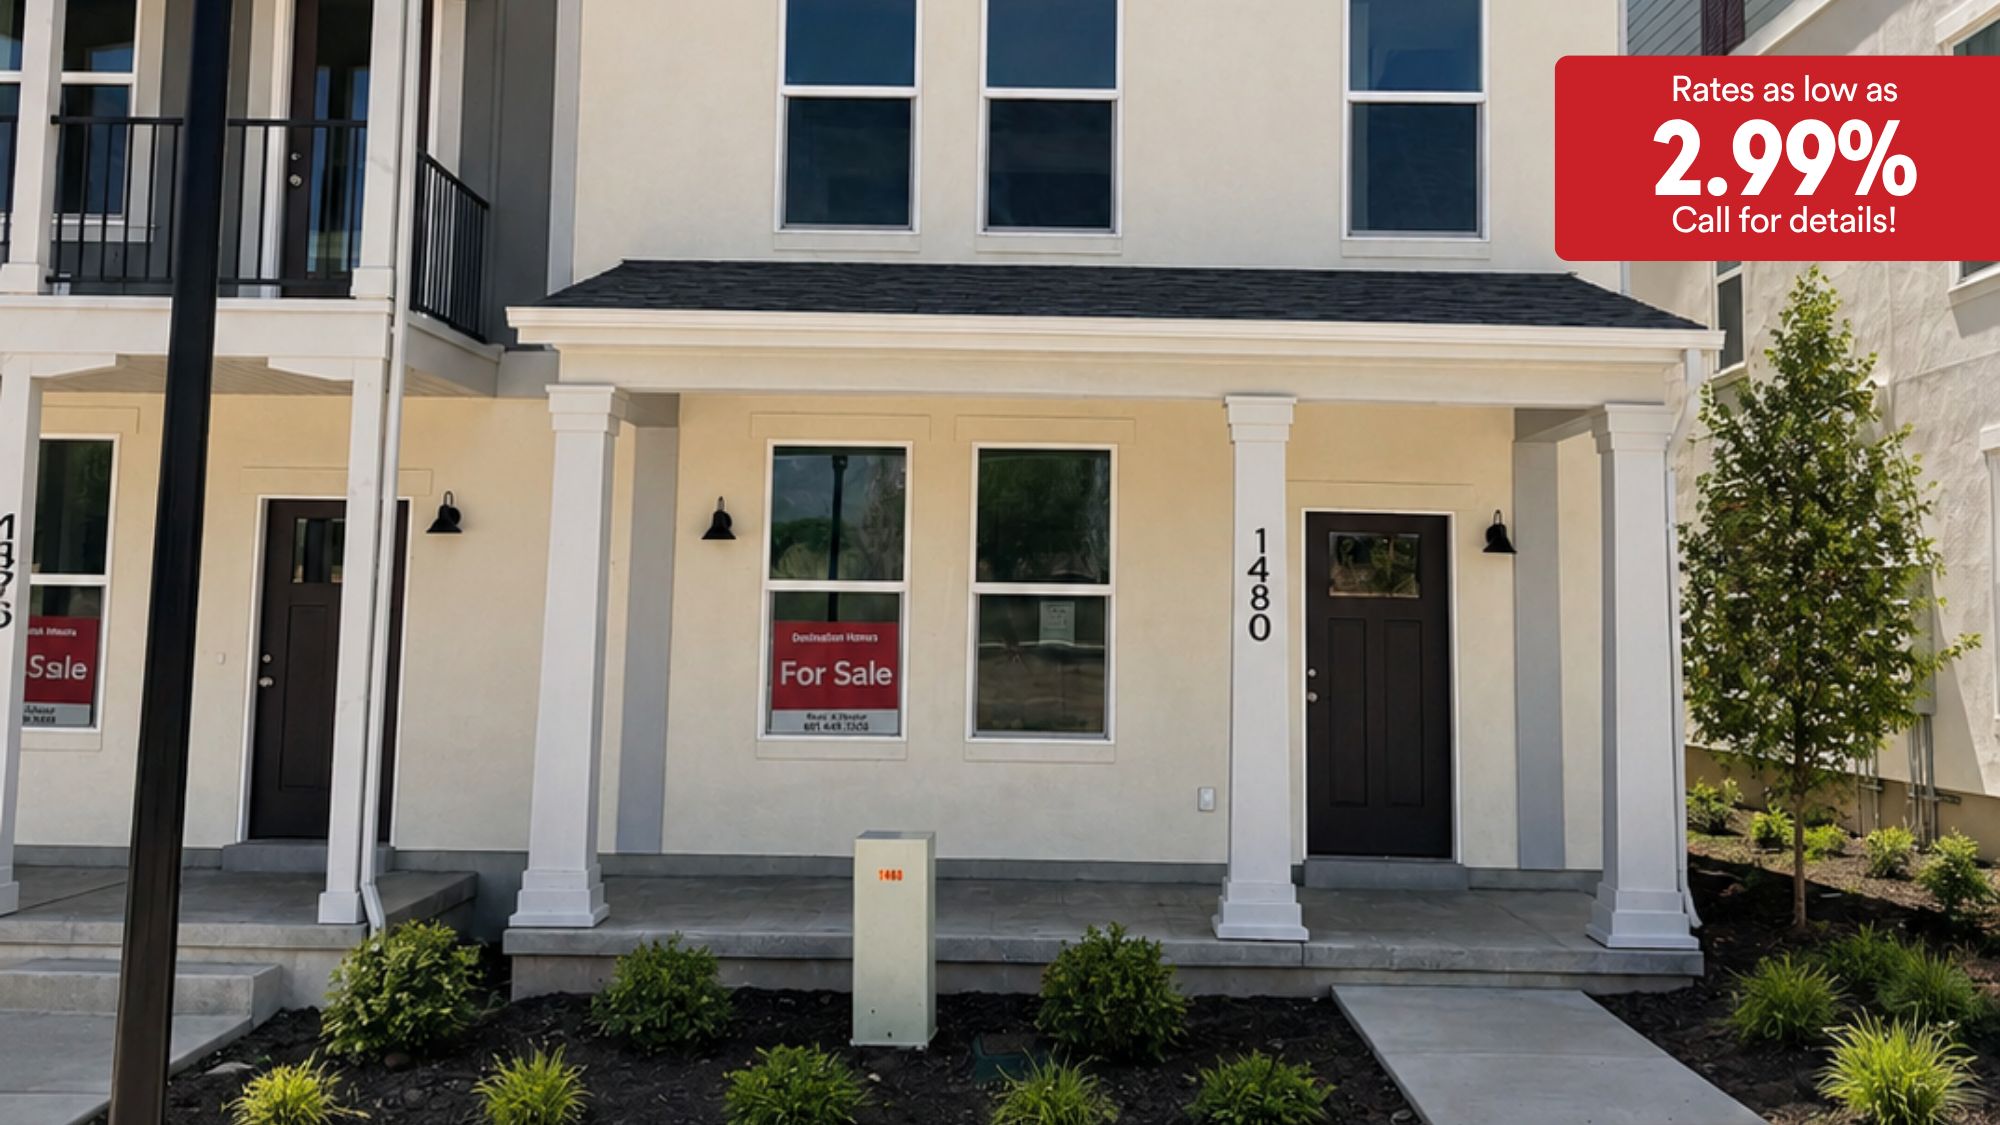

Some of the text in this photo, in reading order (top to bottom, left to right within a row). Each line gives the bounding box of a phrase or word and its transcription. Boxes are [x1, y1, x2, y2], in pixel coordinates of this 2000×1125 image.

[1247, 527, 1271, 642] 1480
[27, 654, 88, 681] Sale
[780, 659, 893, 686] For Sale
